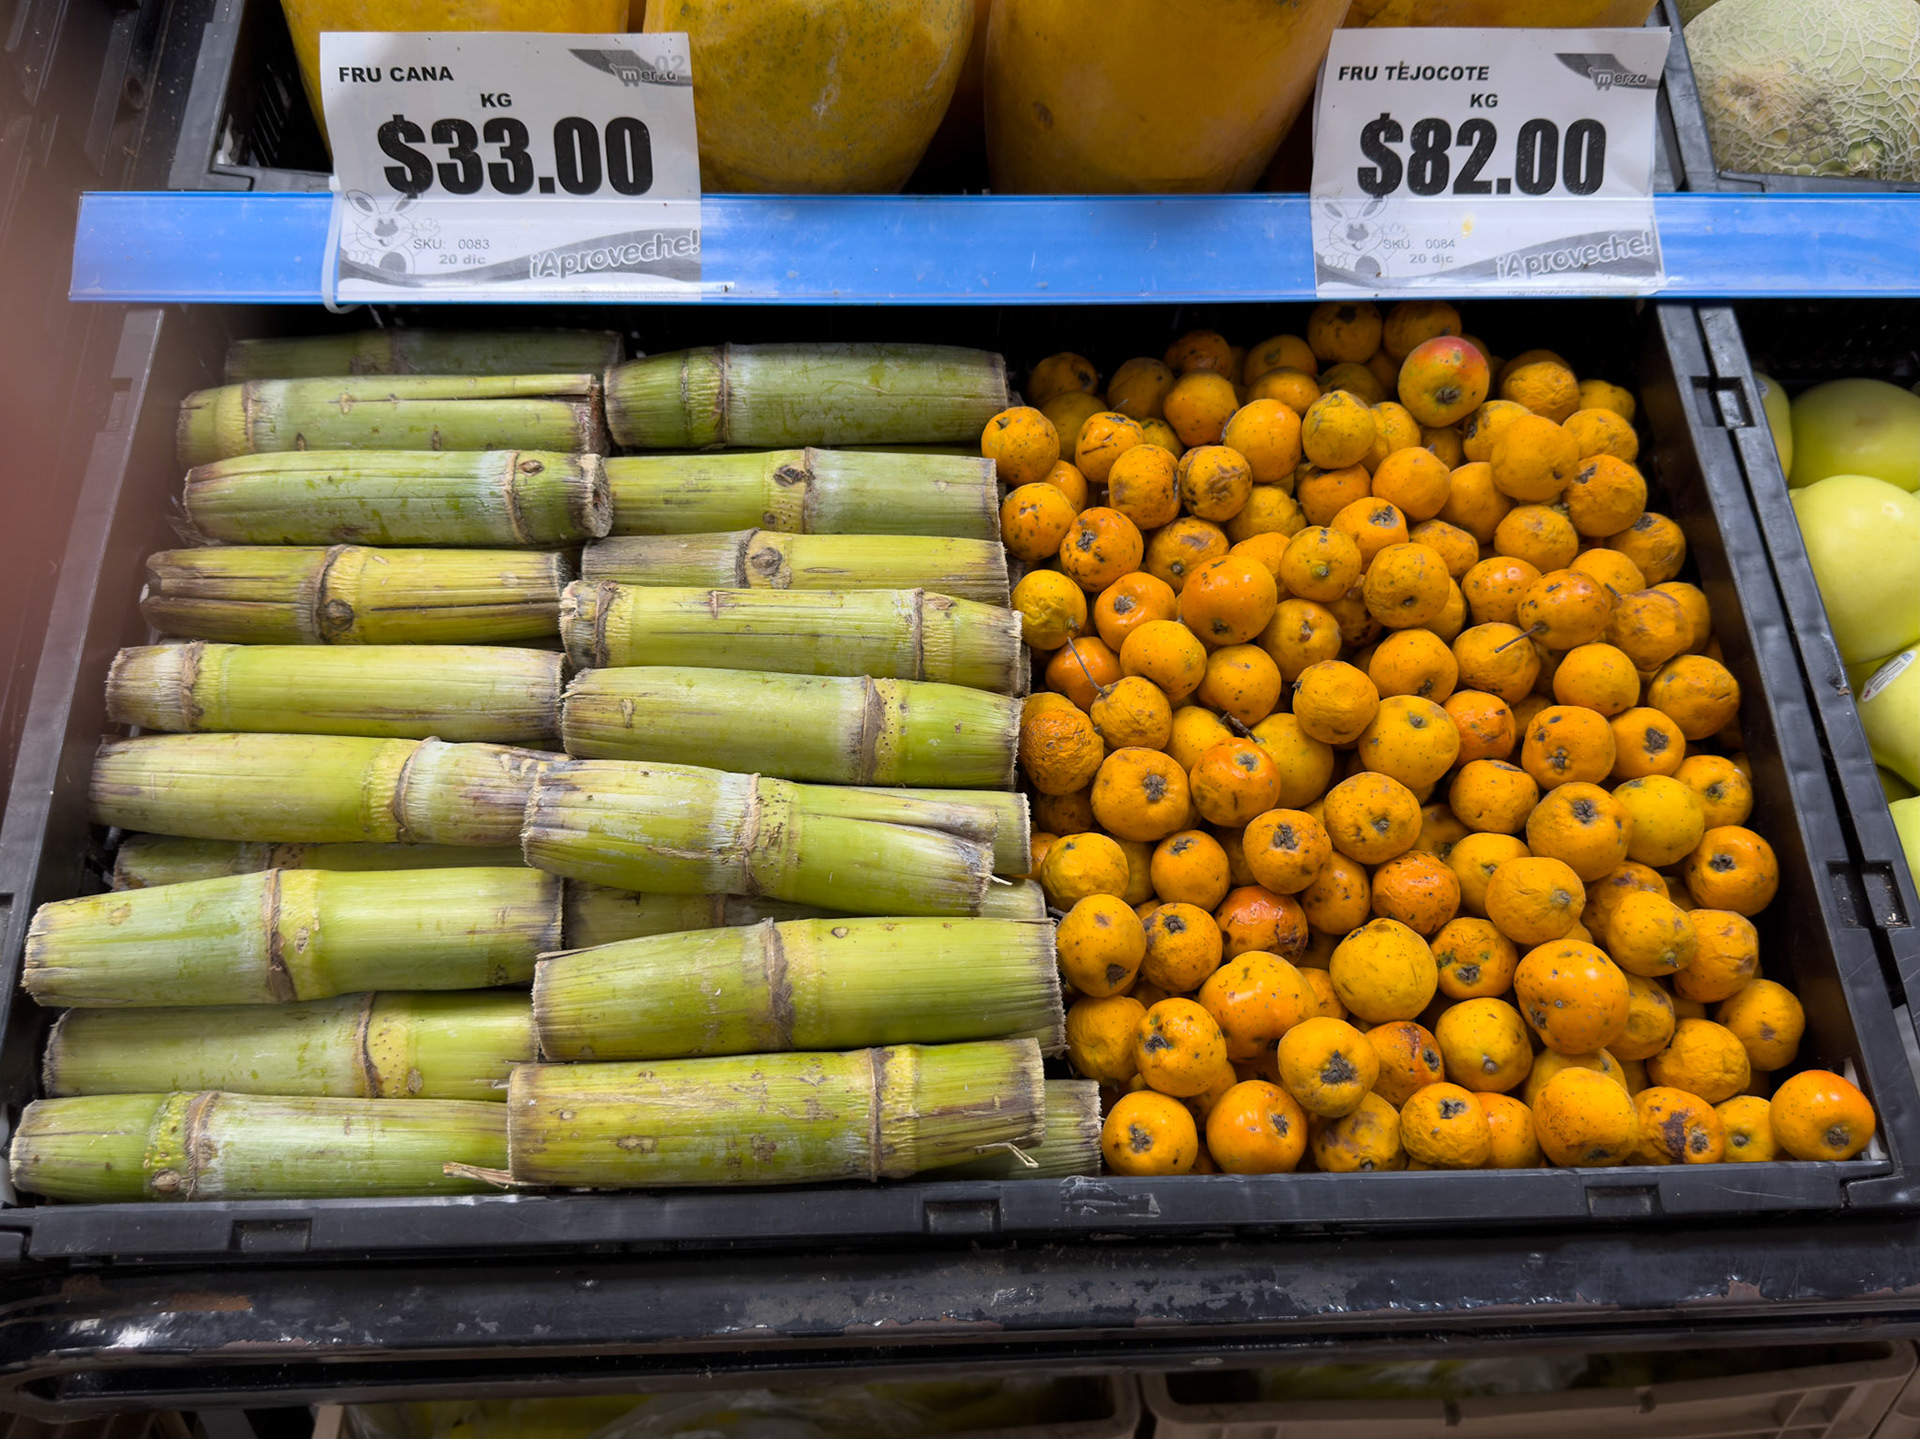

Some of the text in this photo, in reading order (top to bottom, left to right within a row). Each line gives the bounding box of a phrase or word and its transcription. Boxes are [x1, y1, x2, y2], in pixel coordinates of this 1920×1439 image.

[339, 66, 454, 82] FRU CANA
[1338, 66, 1377, 81] FRU
[1597, 73, 1647, 85] merza
[480, 93, 512, 108] KG
[1470, 93, 1498, 108] KG
[377, 114, 653, 199] $33.00
[1357, 113, 1606, 202] $82.00
[458, 238, 490, 250] 0083
[1425, 238, 1455, 250] 0084
[439, 253, 486, 265] 20 dic
[530, 229, 700, 279] ¡Aproveche!
[1409, 252, 1454, 265] 20 dic
[1496, 231, 1654, 280] ¡Aproveche!
